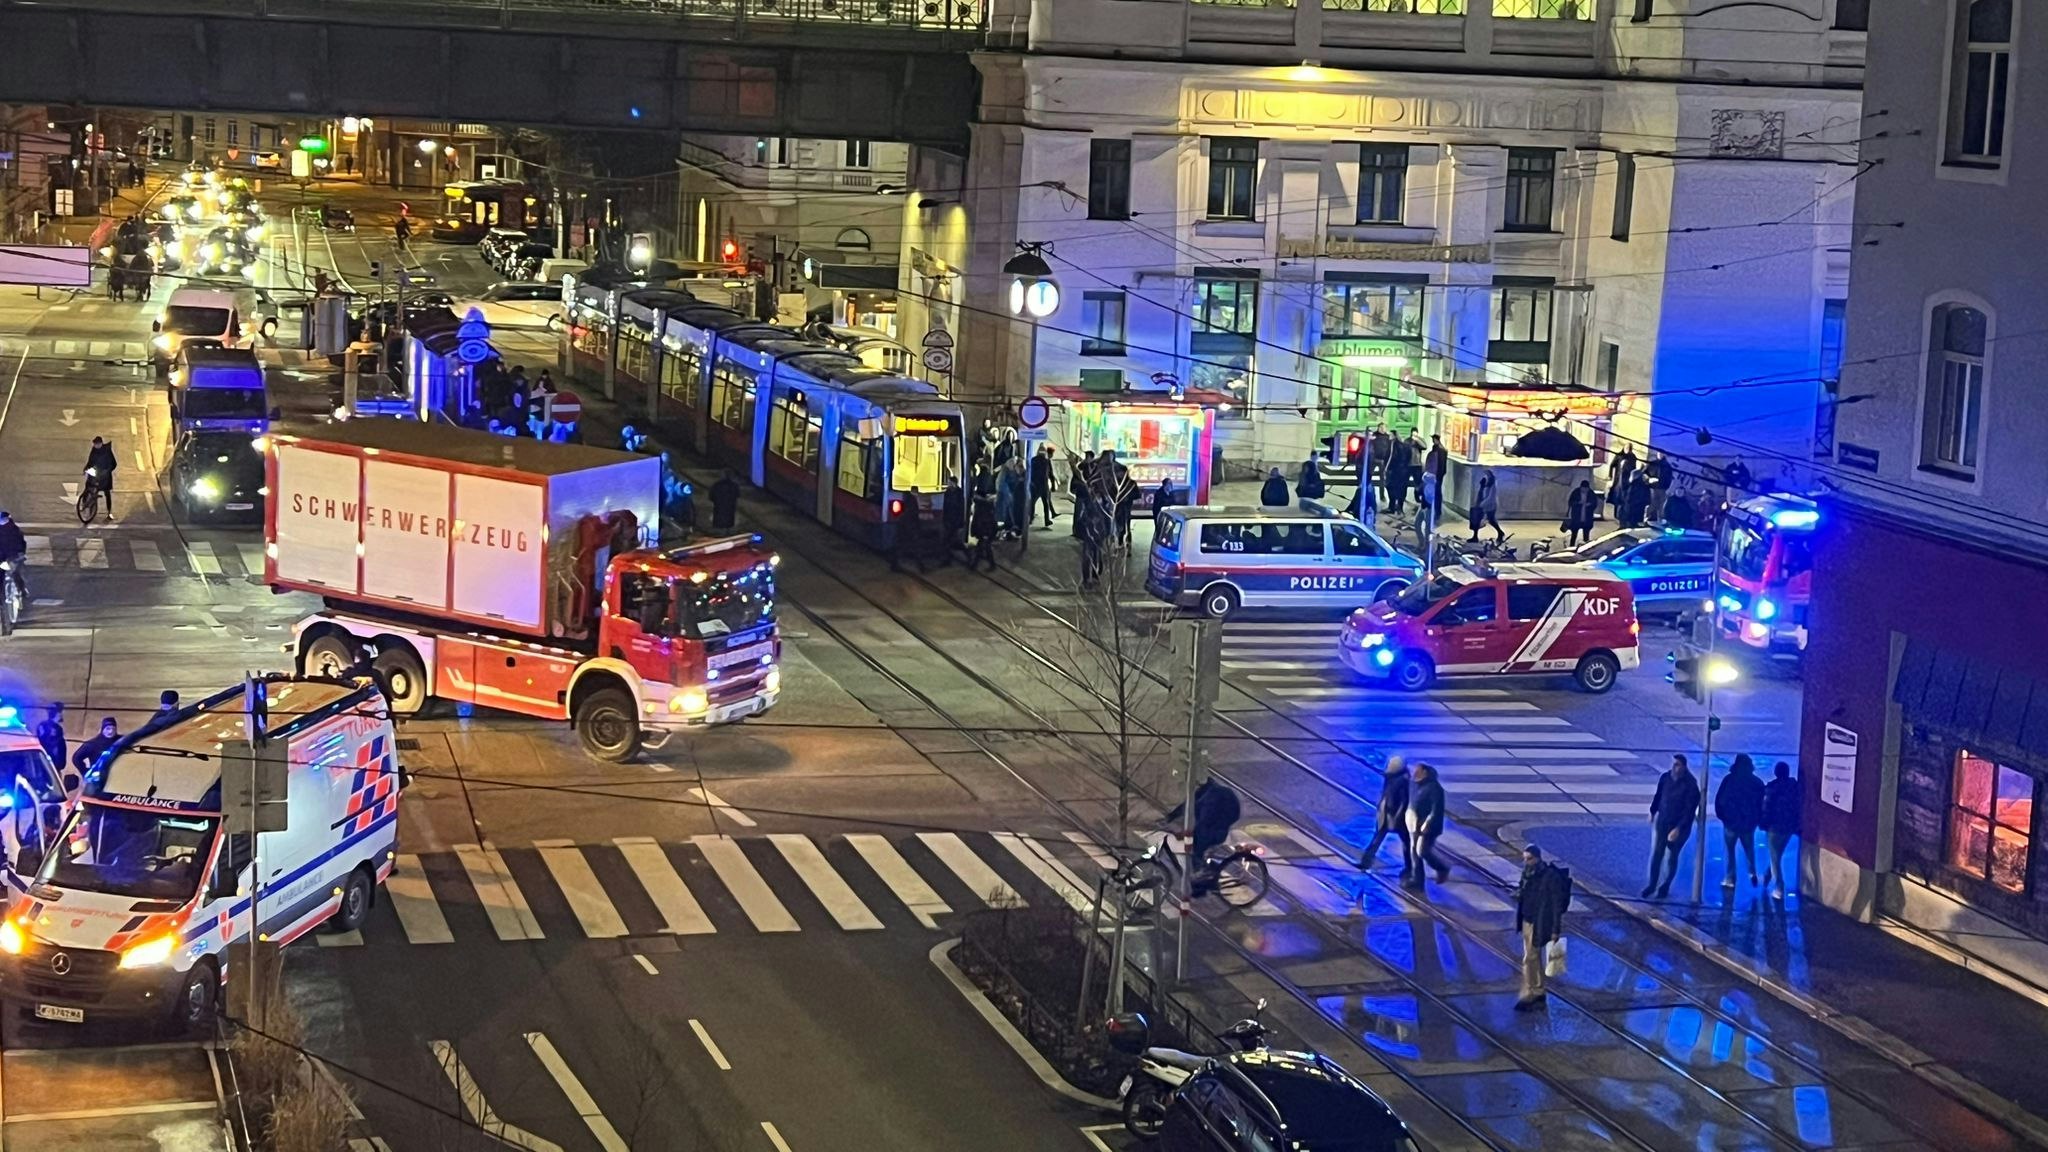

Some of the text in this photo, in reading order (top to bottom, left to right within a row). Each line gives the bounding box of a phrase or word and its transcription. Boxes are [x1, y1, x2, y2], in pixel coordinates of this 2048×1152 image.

[1290, 576, 1354, 589] POLIZEI
[1651, 579, 1698, 592] POLIZEI
[1583, 597, 1620, 616] KDF
[112, 794, 181, 810] AMBULANCE
